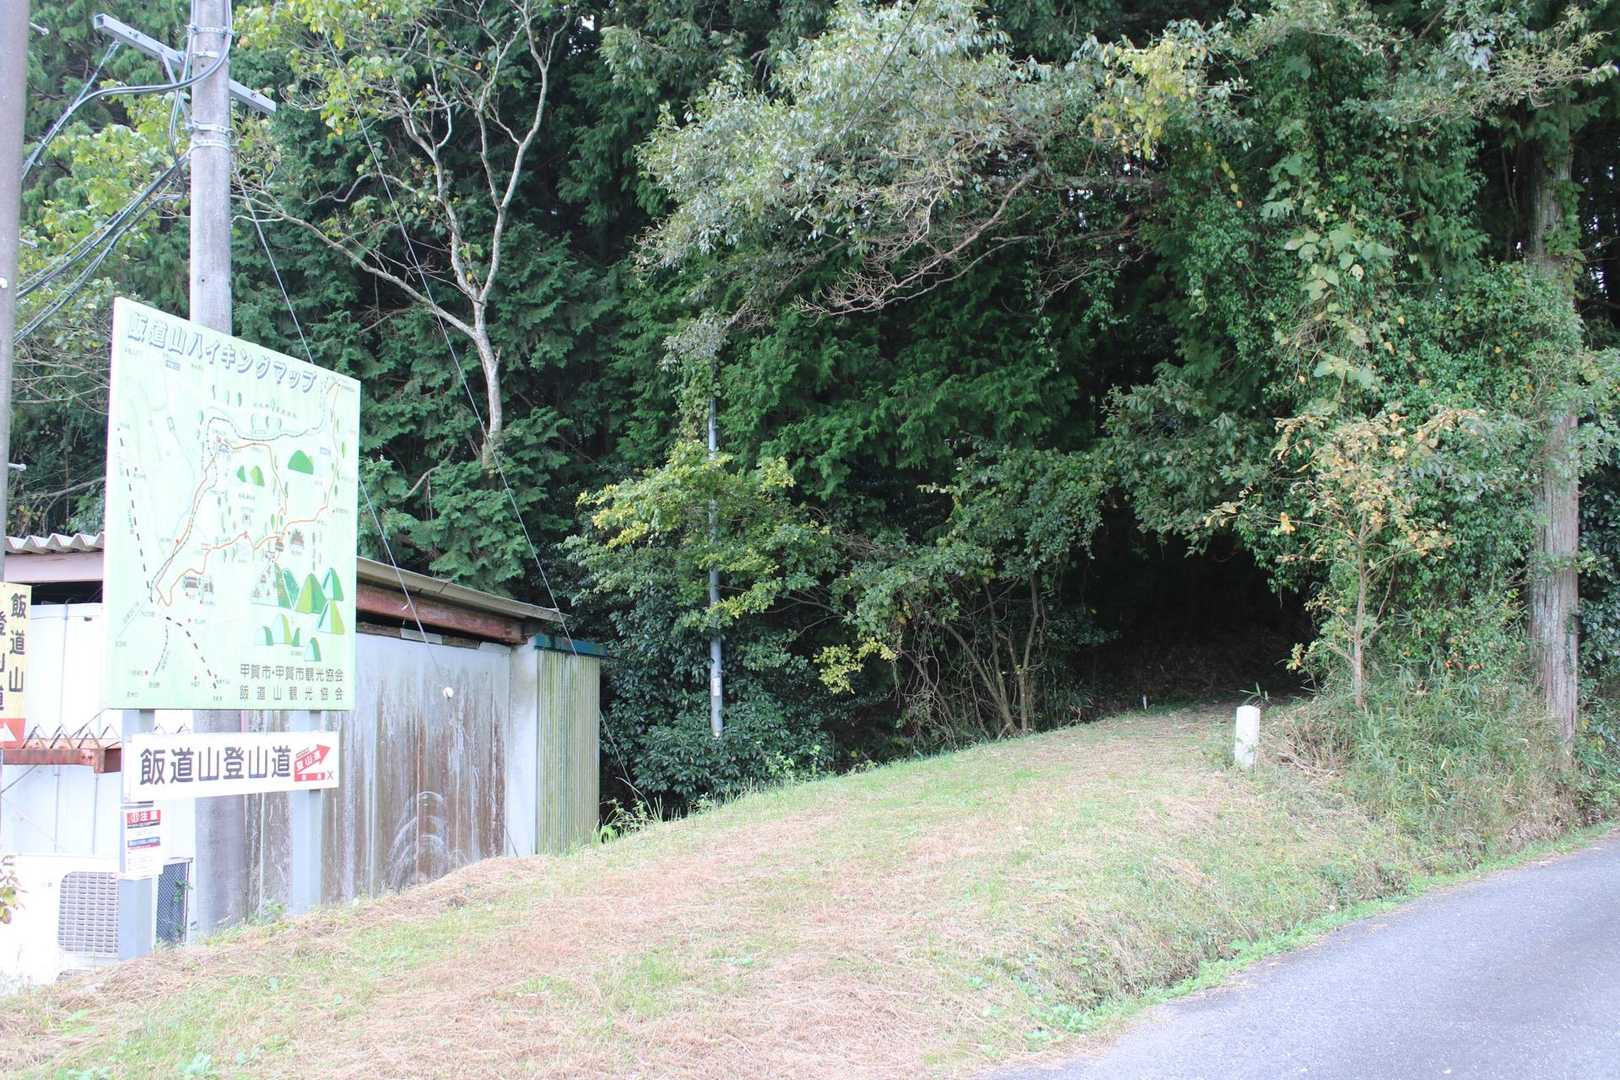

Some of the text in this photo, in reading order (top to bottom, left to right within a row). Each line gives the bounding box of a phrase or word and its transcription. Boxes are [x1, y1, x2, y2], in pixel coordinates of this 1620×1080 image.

[9, 592, 27, 692] 飯道山
[139, 745, 291, 785] 飯道山登山道
